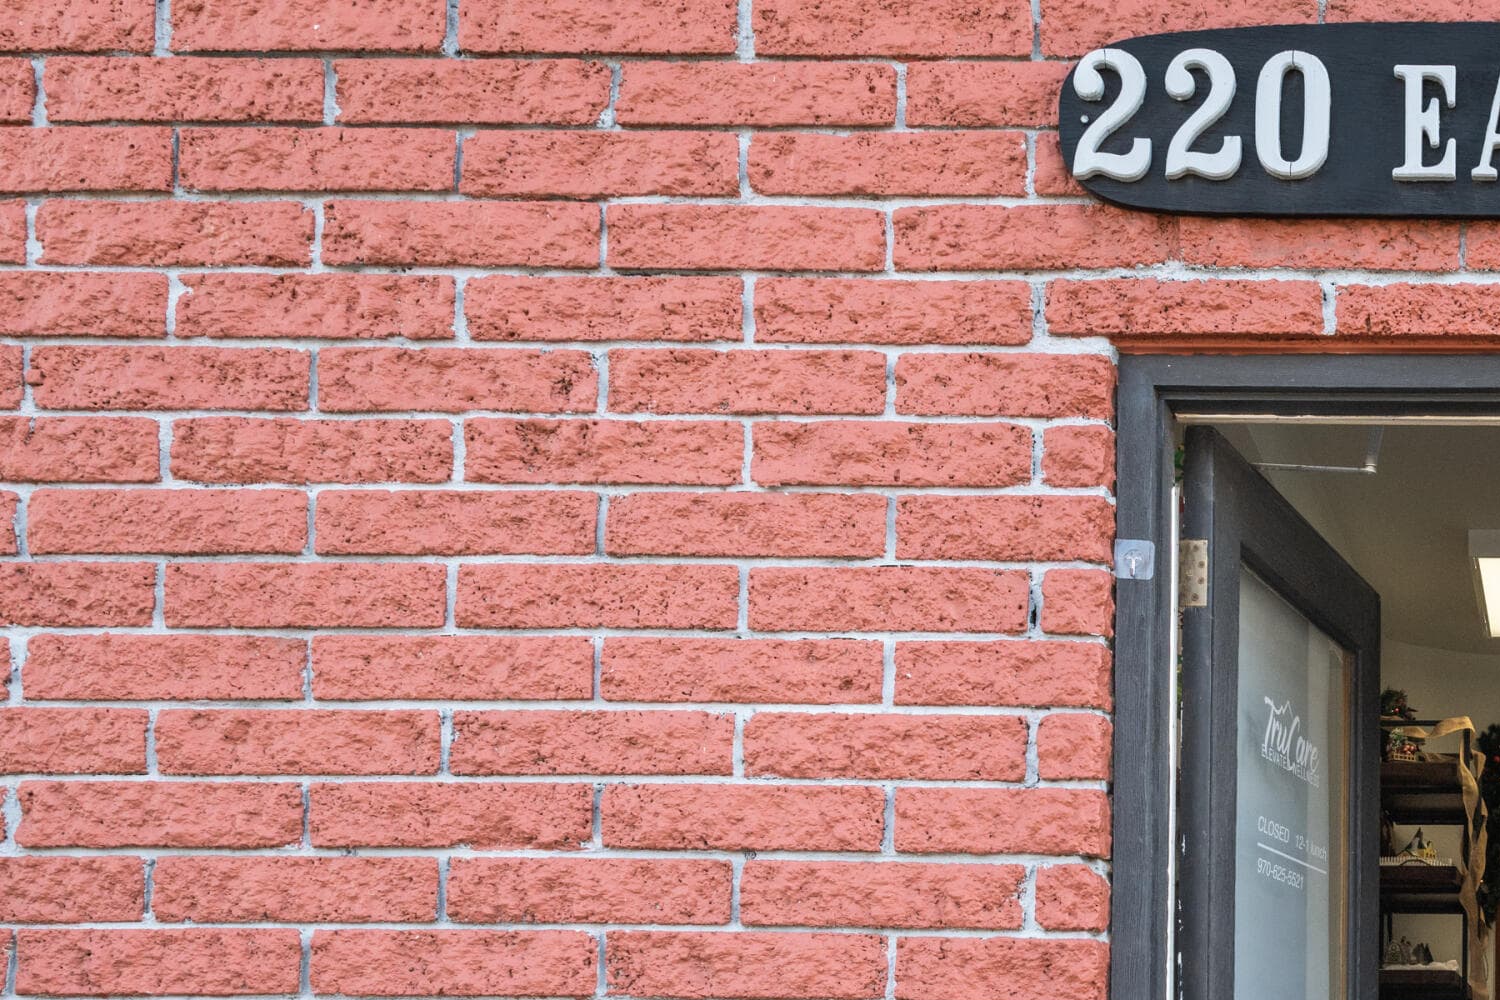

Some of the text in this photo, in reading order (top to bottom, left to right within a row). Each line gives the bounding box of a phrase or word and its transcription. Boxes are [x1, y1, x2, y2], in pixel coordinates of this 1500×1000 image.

[1073, 48, 1330, 181] 220
[1263, 696, 1320, 772] TruCare
[1257, 816, 1290, 843] CLOSED
